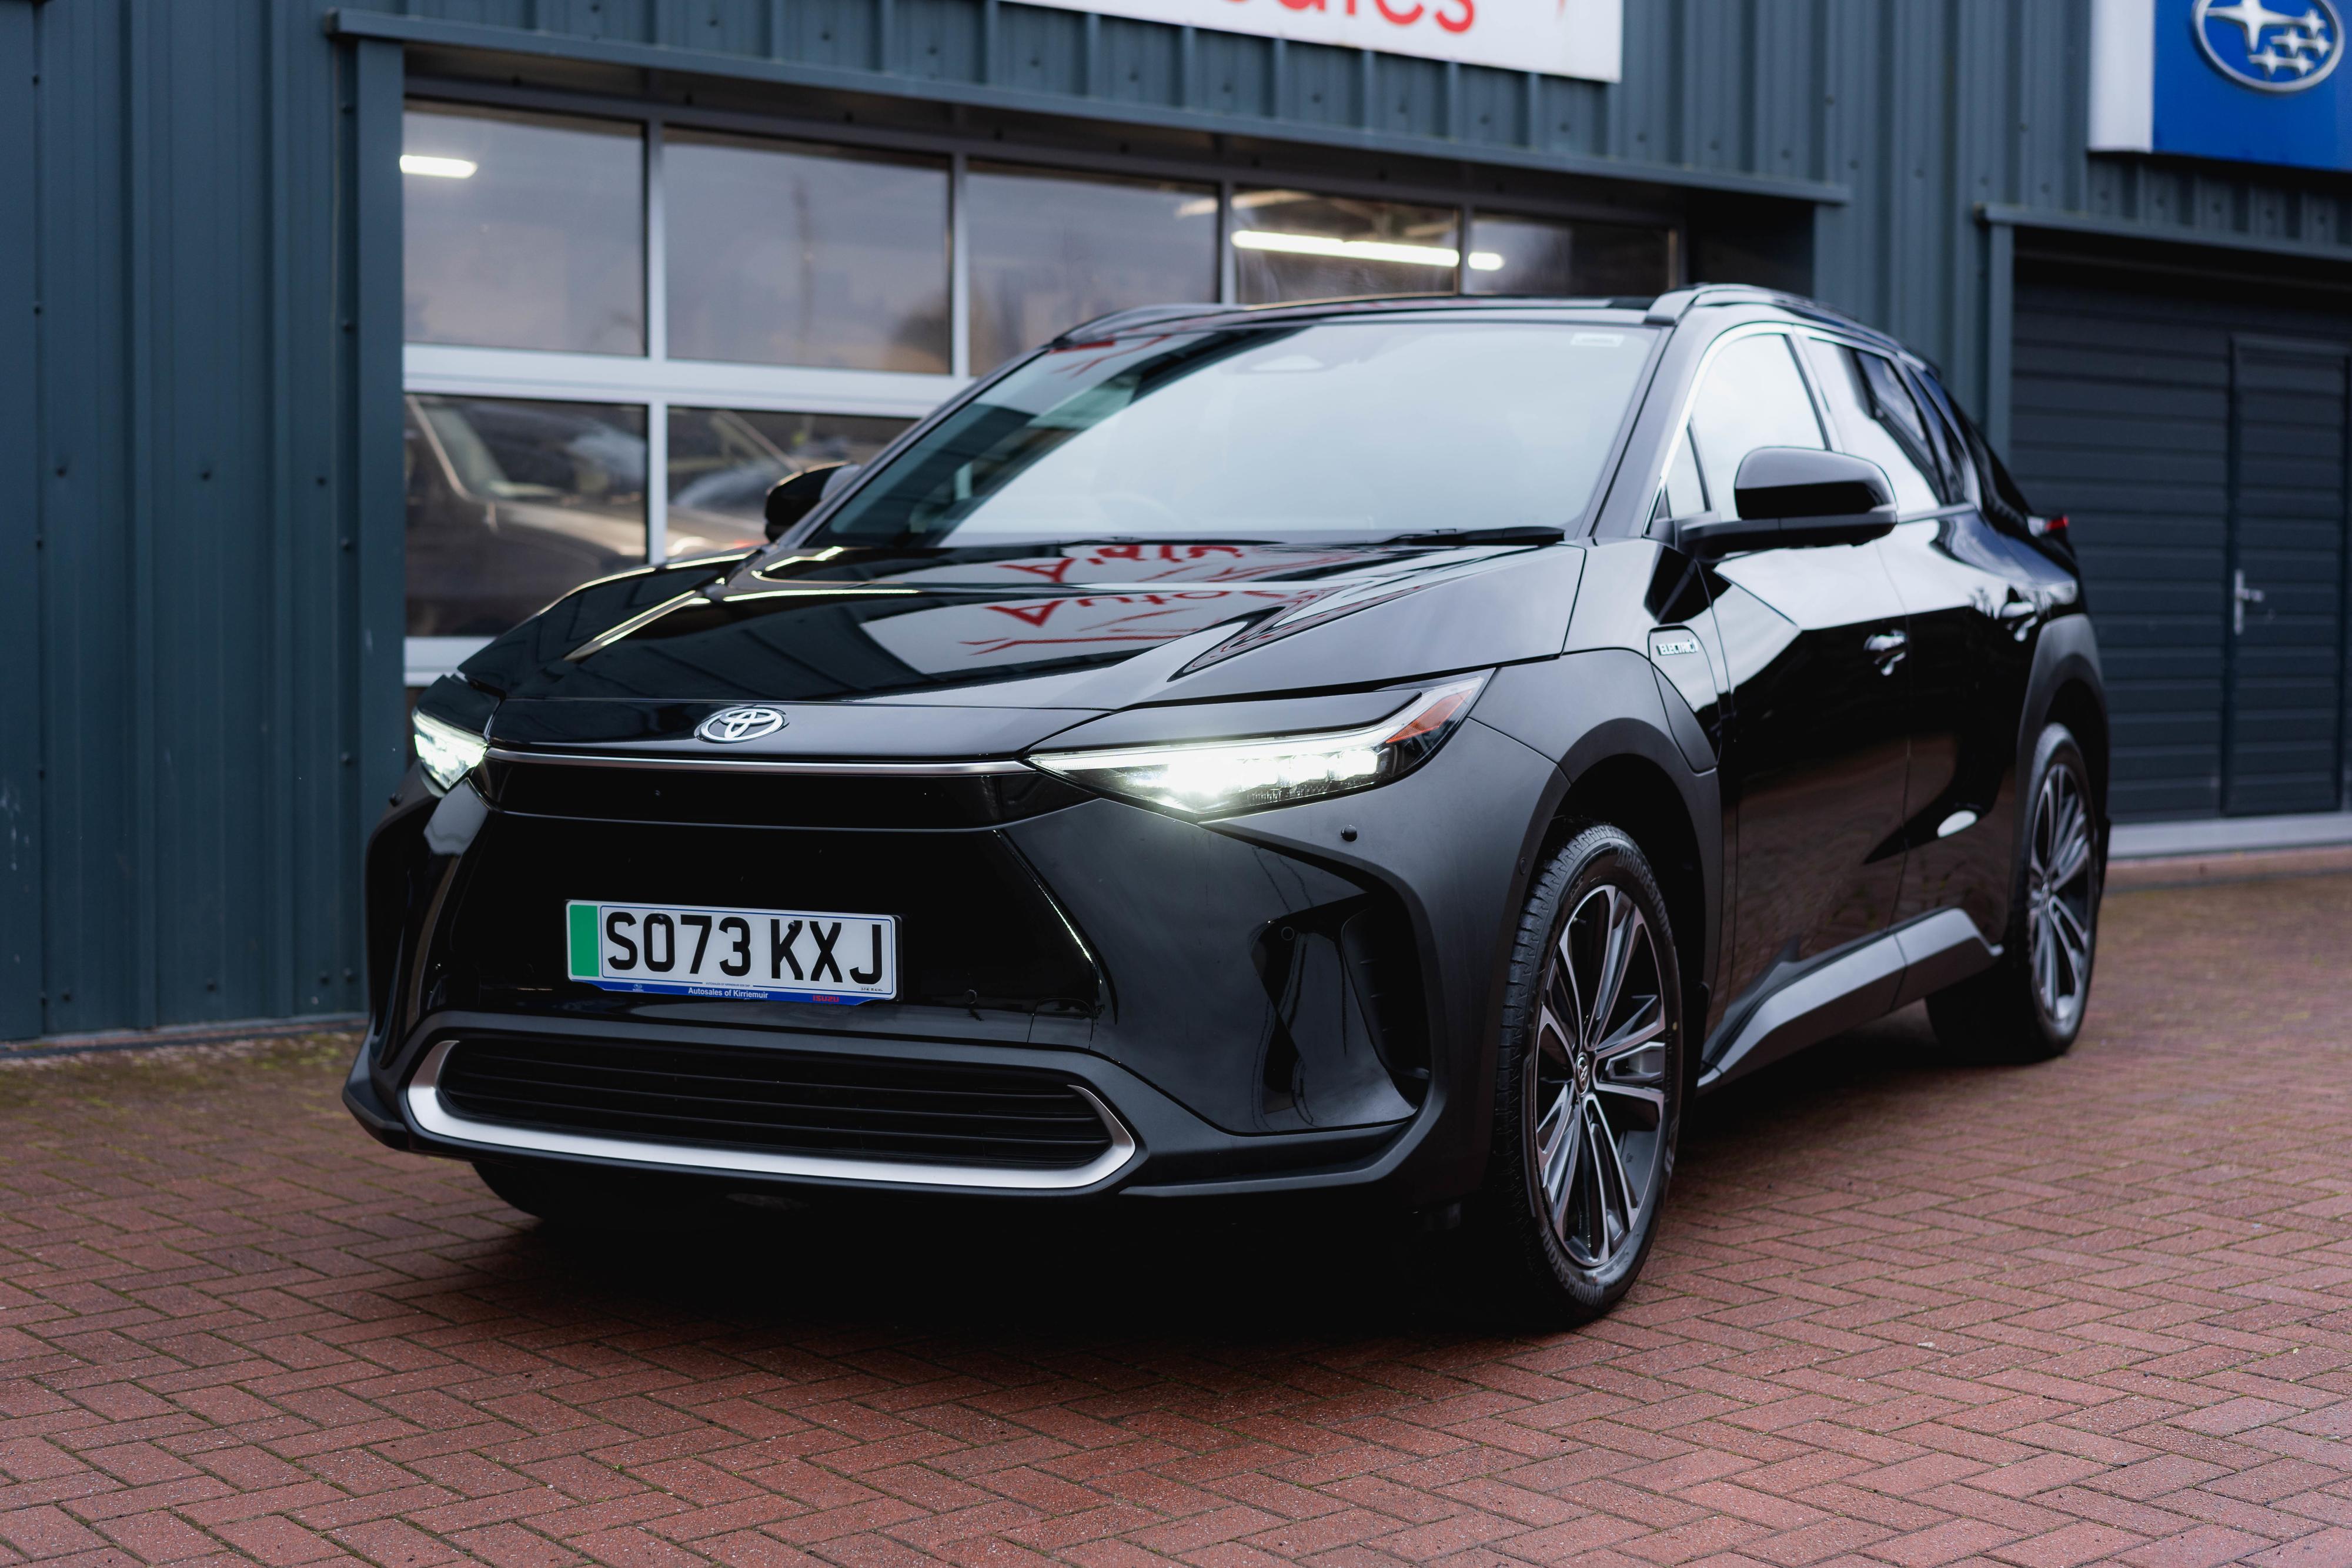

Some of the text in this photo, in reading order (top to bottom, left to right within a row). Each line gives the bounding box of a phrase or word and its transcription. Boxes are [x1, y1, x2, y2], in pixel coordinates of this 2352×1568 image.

[606, 911, 883, 985] SO73 KXJ
[688, 987, 769, 998] Autosales of Kirriemuir
